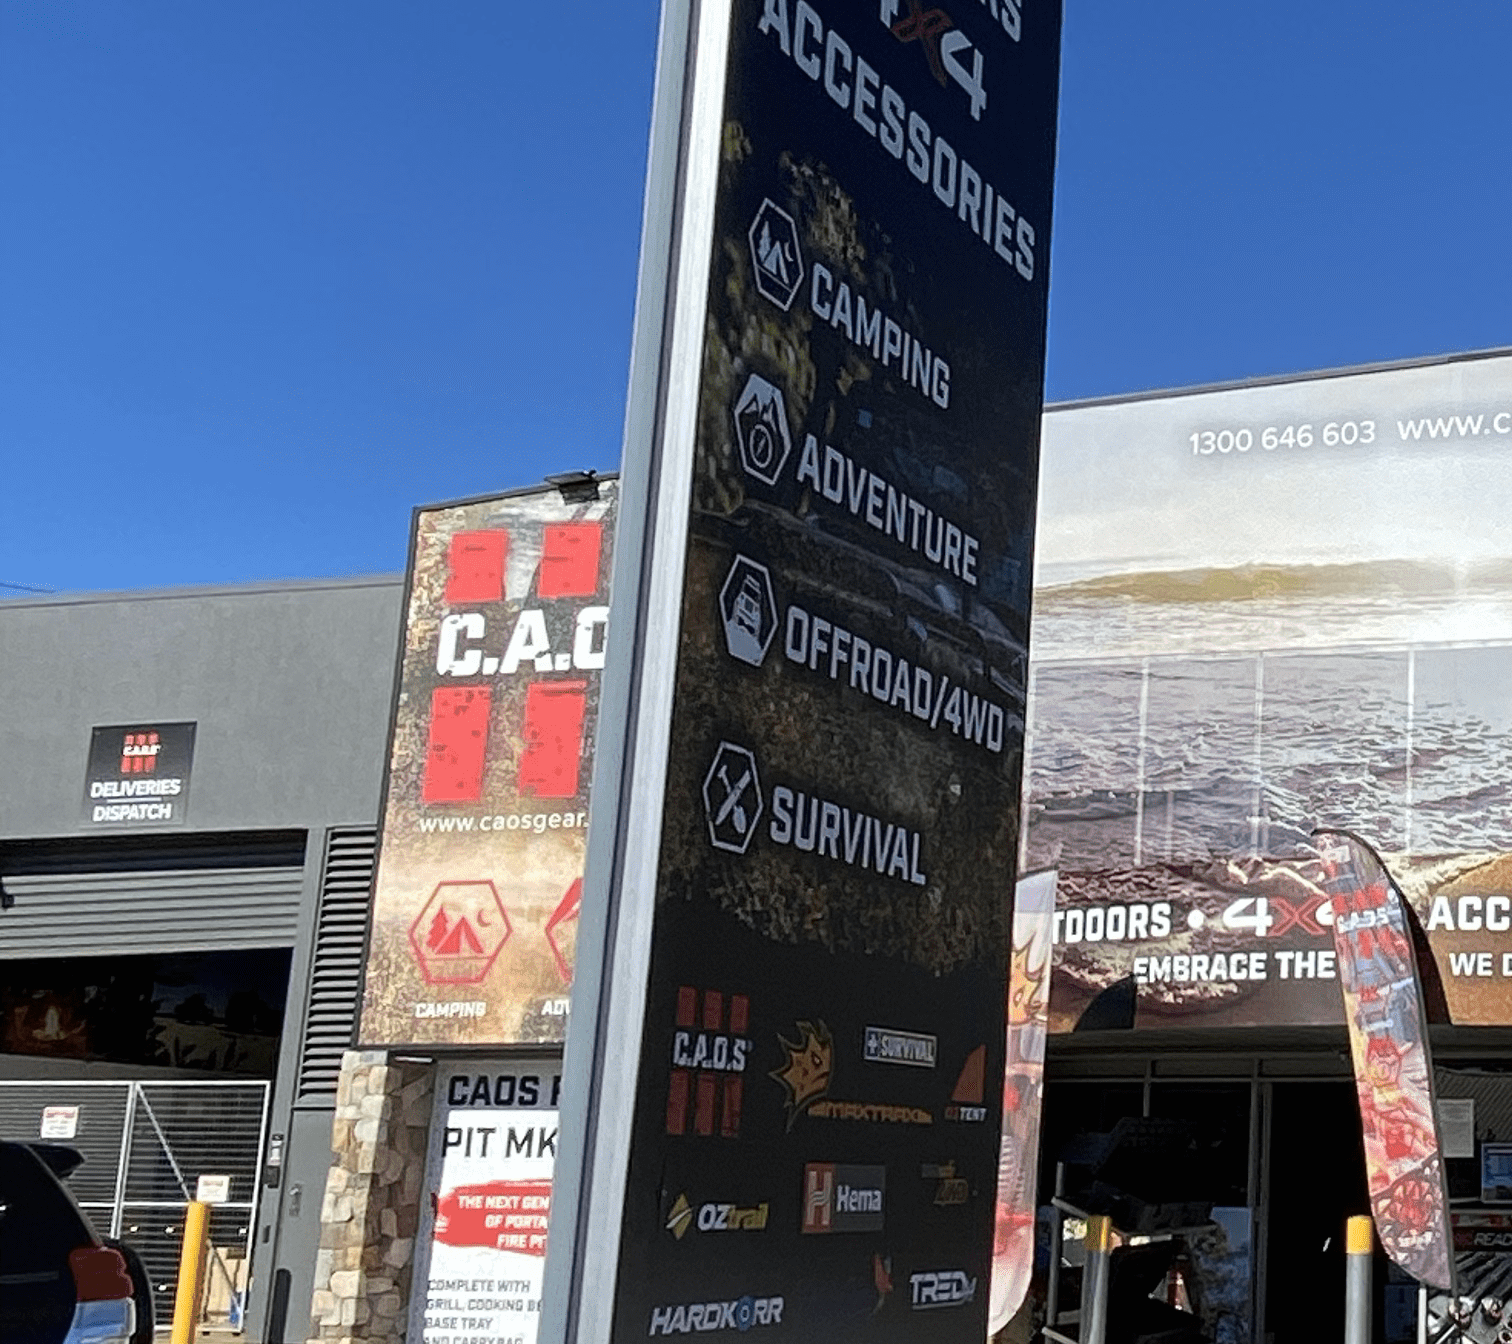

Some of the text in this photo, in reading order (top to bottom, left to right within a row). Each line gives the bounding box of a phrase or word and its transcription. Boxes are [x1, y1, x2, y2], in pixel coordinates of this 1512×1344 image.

[810, 261, 950, 410] CAMPING
[1189, 428, 1253, 456] 1300
[1261, 426, 1314, 450] 646
[1321, 419, 1376, 448] 603
[796, 432, 981, 587] ADVENTURE
[785, 604, 1004, 753] OFFROAD/4WD
[90, 778, 182, 798] DELIVERIES
[92, 803, 172, 822] DISPATCH
[770, 785, 927, 887] SURVIVAL
[1133, 952, 1267, 985] EMBRACE
[1275, 950, 1336, 980] THE
[1450, 952, 1493, 976] WE
[414, 1001, 487, 1018] CAMPING
[880, 1035, 935, 1062] SURVIVAL
[447, 1074, 540, 1106] CAOS
[441, 1126, 497, 1158] PIT
[458, 1195, 483, 1209] THE
[485, 1195, 520, 1209] NEXT
[836, 1184, 882, 1213] Hema
[485, 1214, 503, 1228] OF
[698, 1203, 769, 1232] OZtrail
[497, 1234, 526, 1248] FIRE
[427, 1279, 531, 1293] COMPLETE WITH
[467, 1299, 524, 1312] COOKING
[649, 1296, 784, 1336] HARDKORR
[426, 1317, 494, 1330] BASE TRAY
